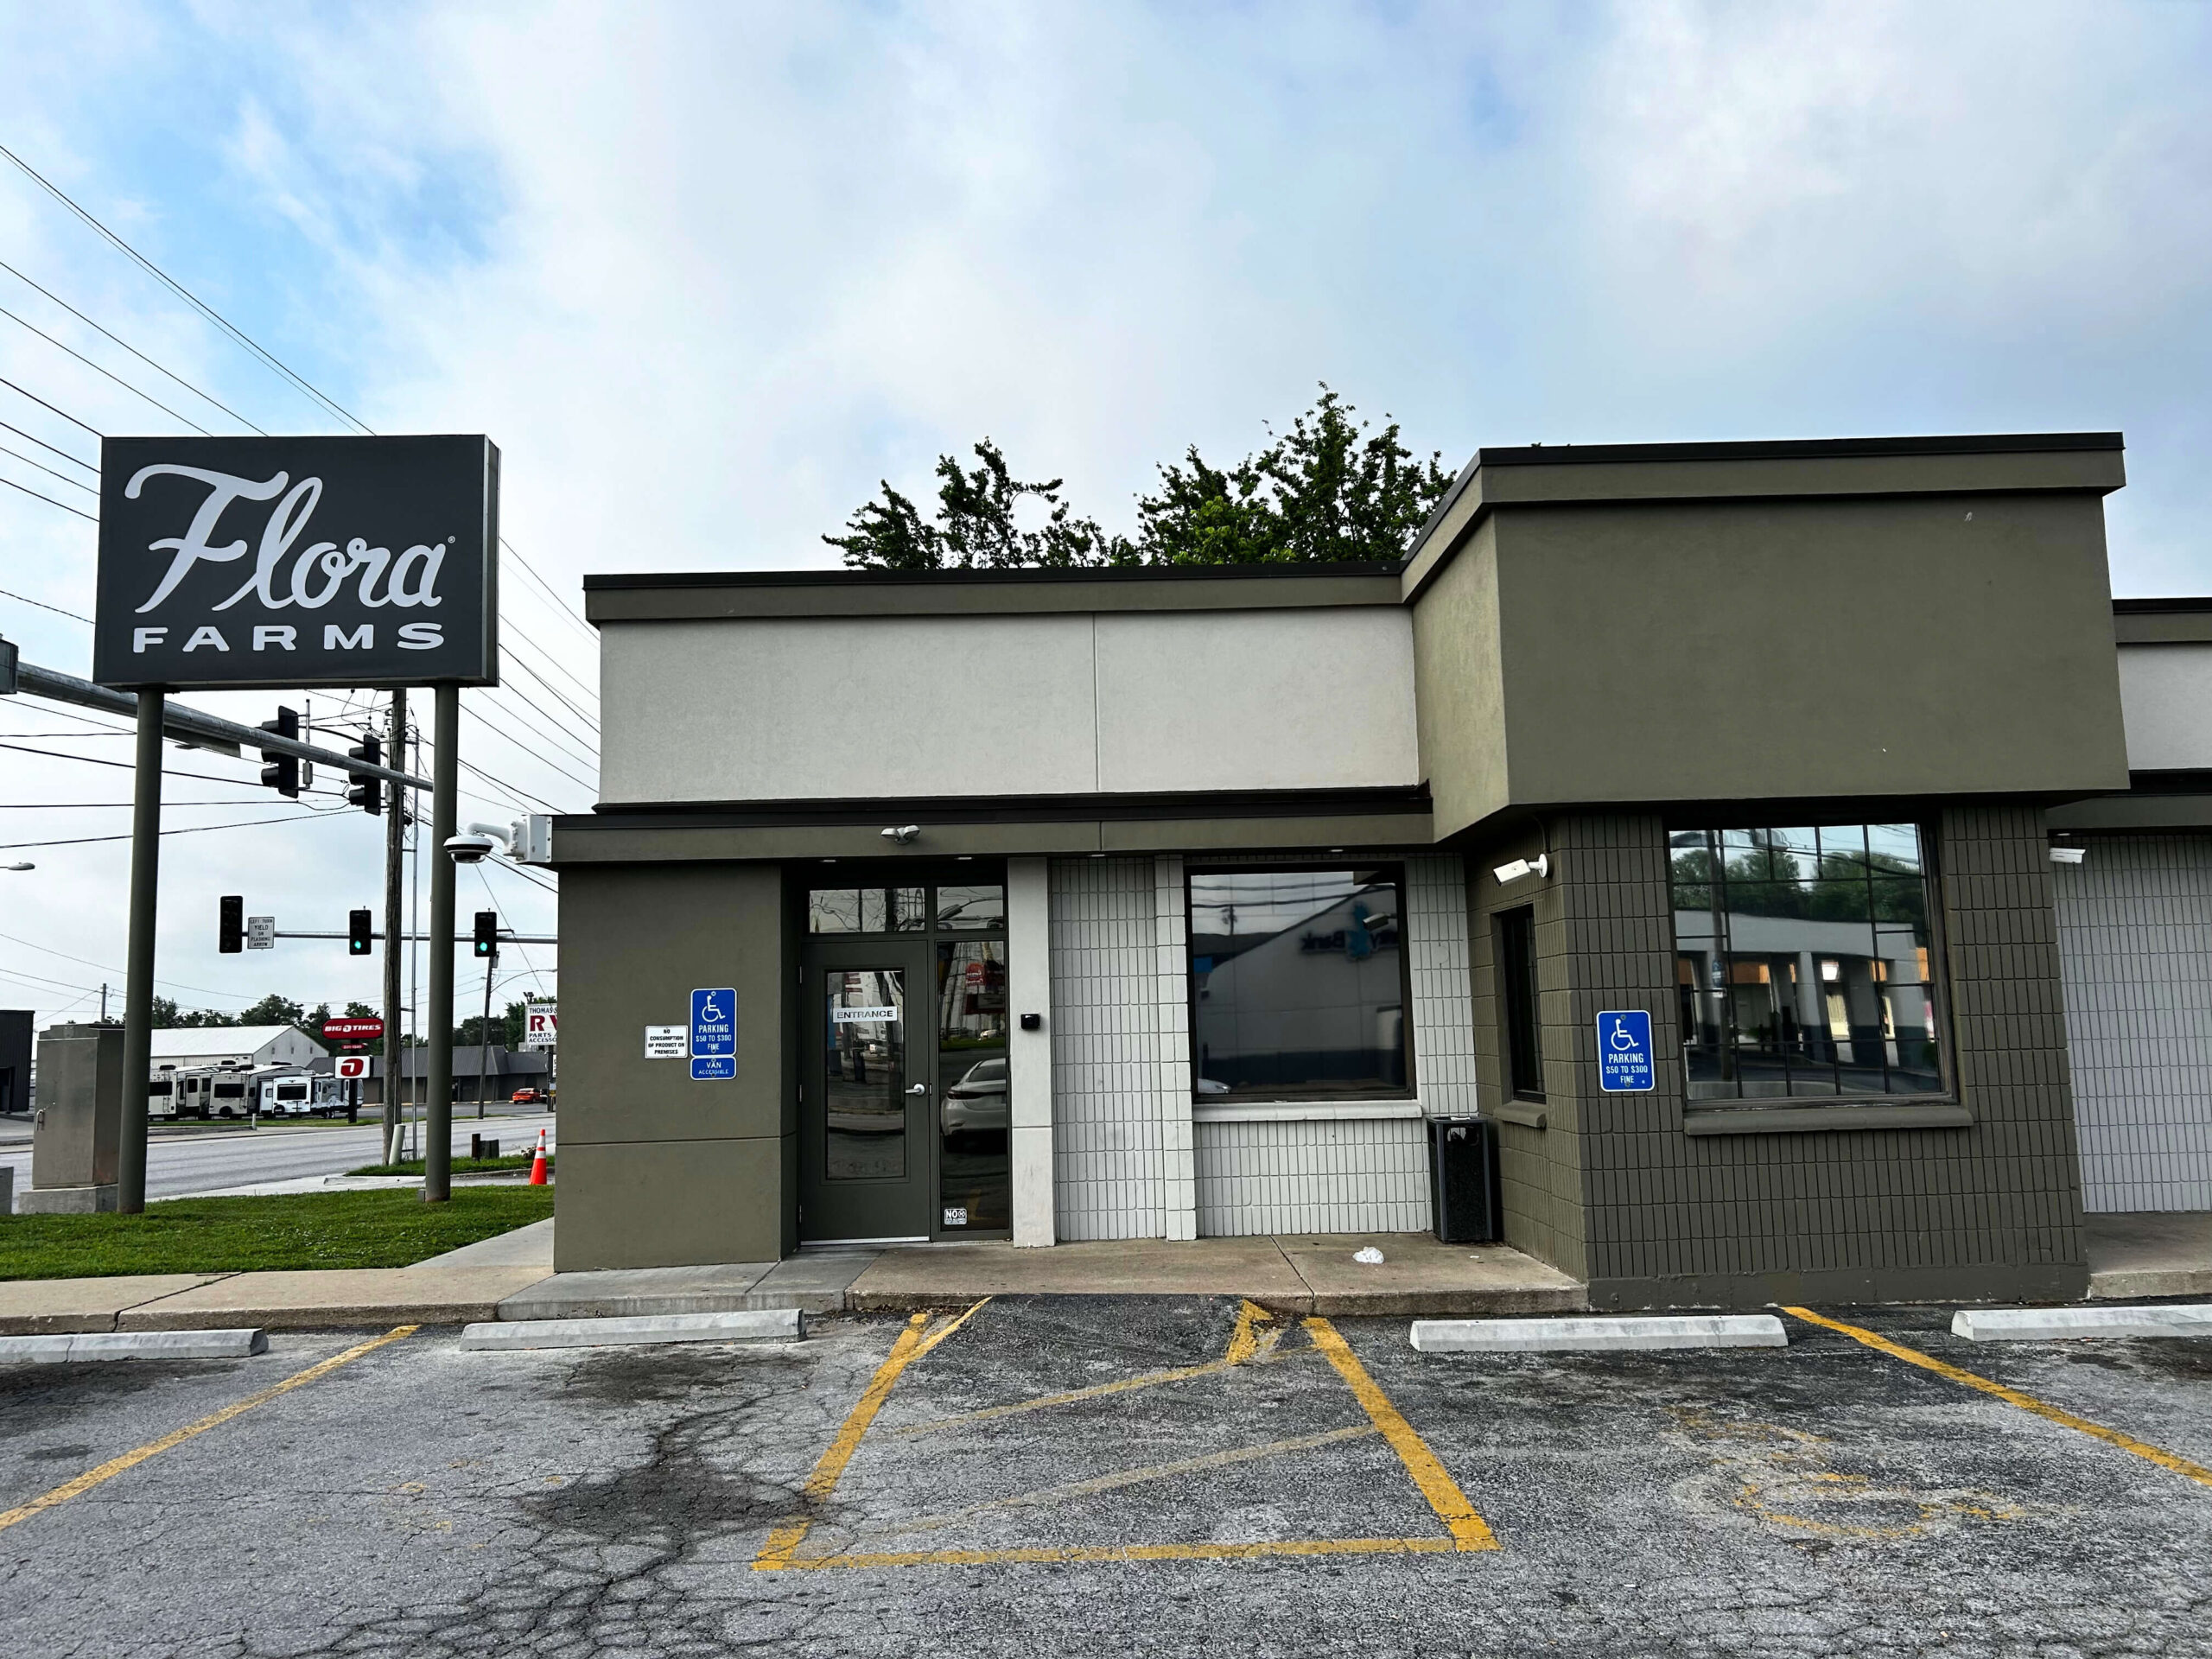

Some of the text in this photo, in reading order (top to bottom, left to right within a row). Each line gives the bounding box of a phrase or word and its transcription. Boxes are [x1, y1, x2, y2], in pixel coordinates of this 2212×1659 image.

[124, 463, 447, 613] Flora
[132, 622, 444, 653] FARMS
[836, 1010, 893, 1019] ENTRANCE
[698, 1024, 729, 1033] PARKING
[1608, 1053, 1644, 1064] PARKING
[1605, 1065, 1619, 1074] $50
[1630, 1065, 1648, 1073] $300
[1620, 1075, 1635, 1084] FINE
[946, 1210, 958, 1218] NO
